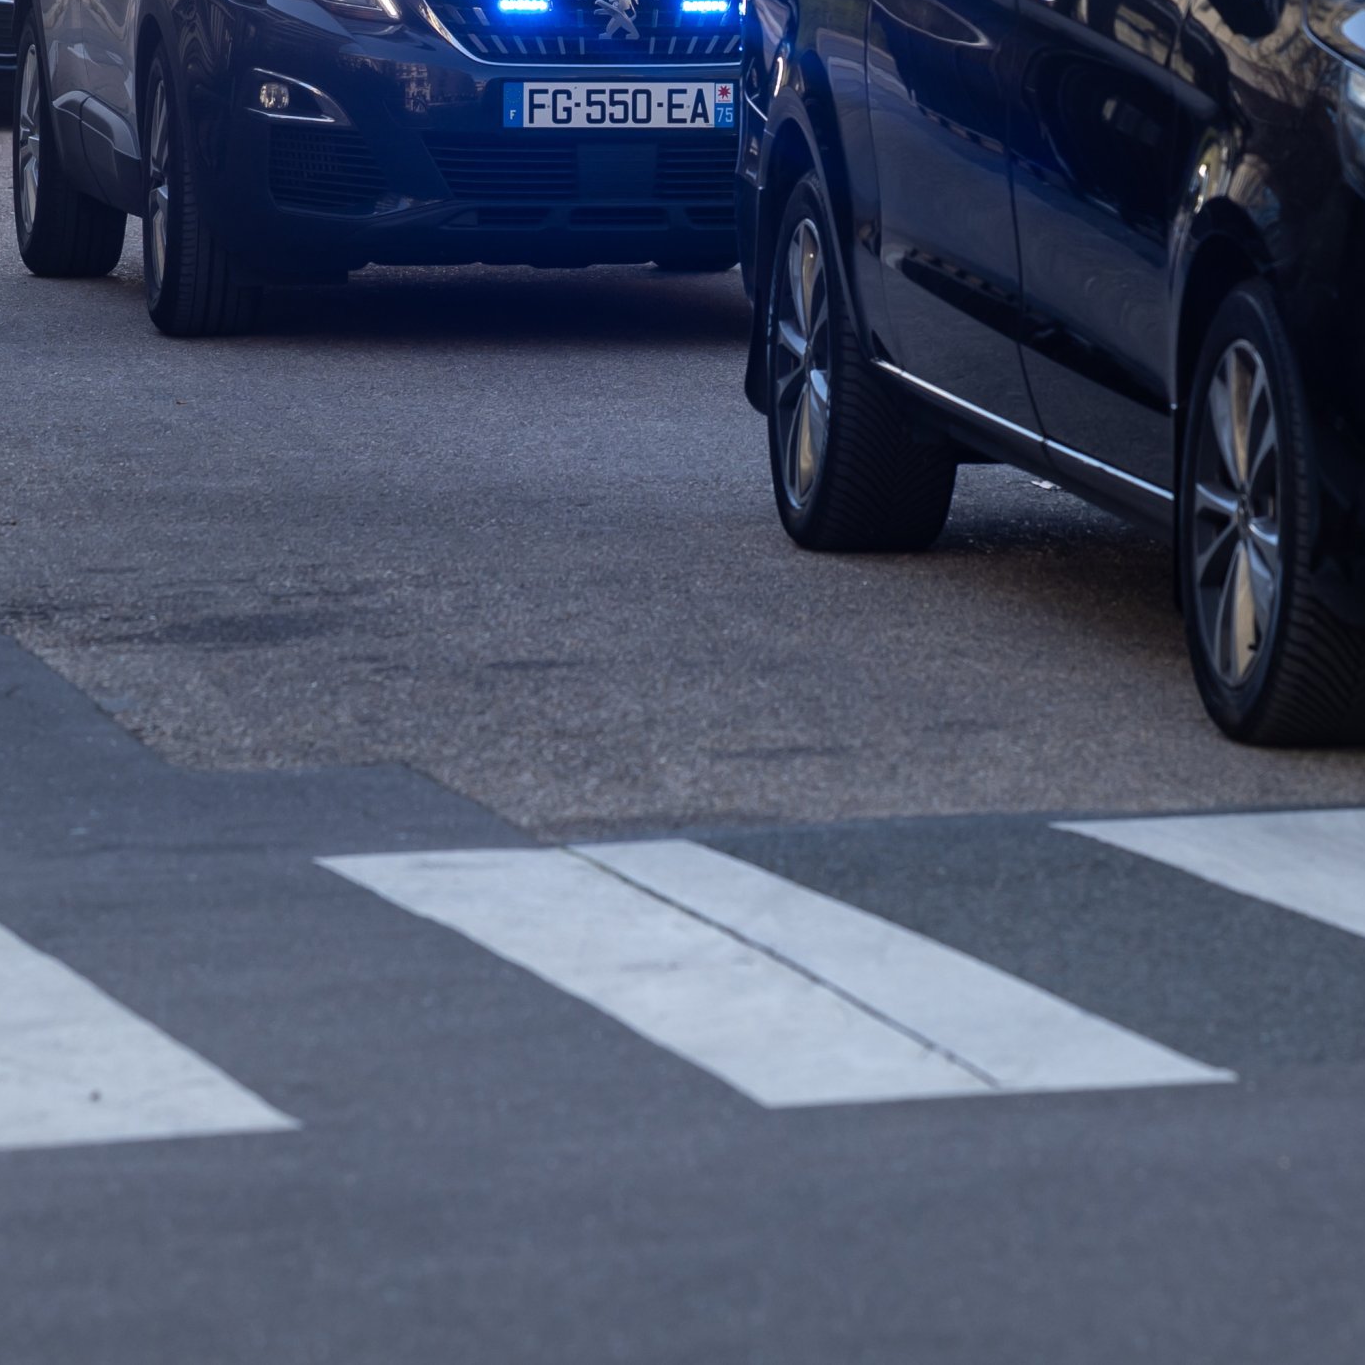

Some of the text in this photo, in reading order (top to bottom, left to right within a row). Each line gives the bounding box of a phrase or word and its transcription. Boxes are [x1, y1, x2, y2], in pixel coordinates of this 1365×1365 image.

[509, 88, 734, 125] F FG-550-EA 75
